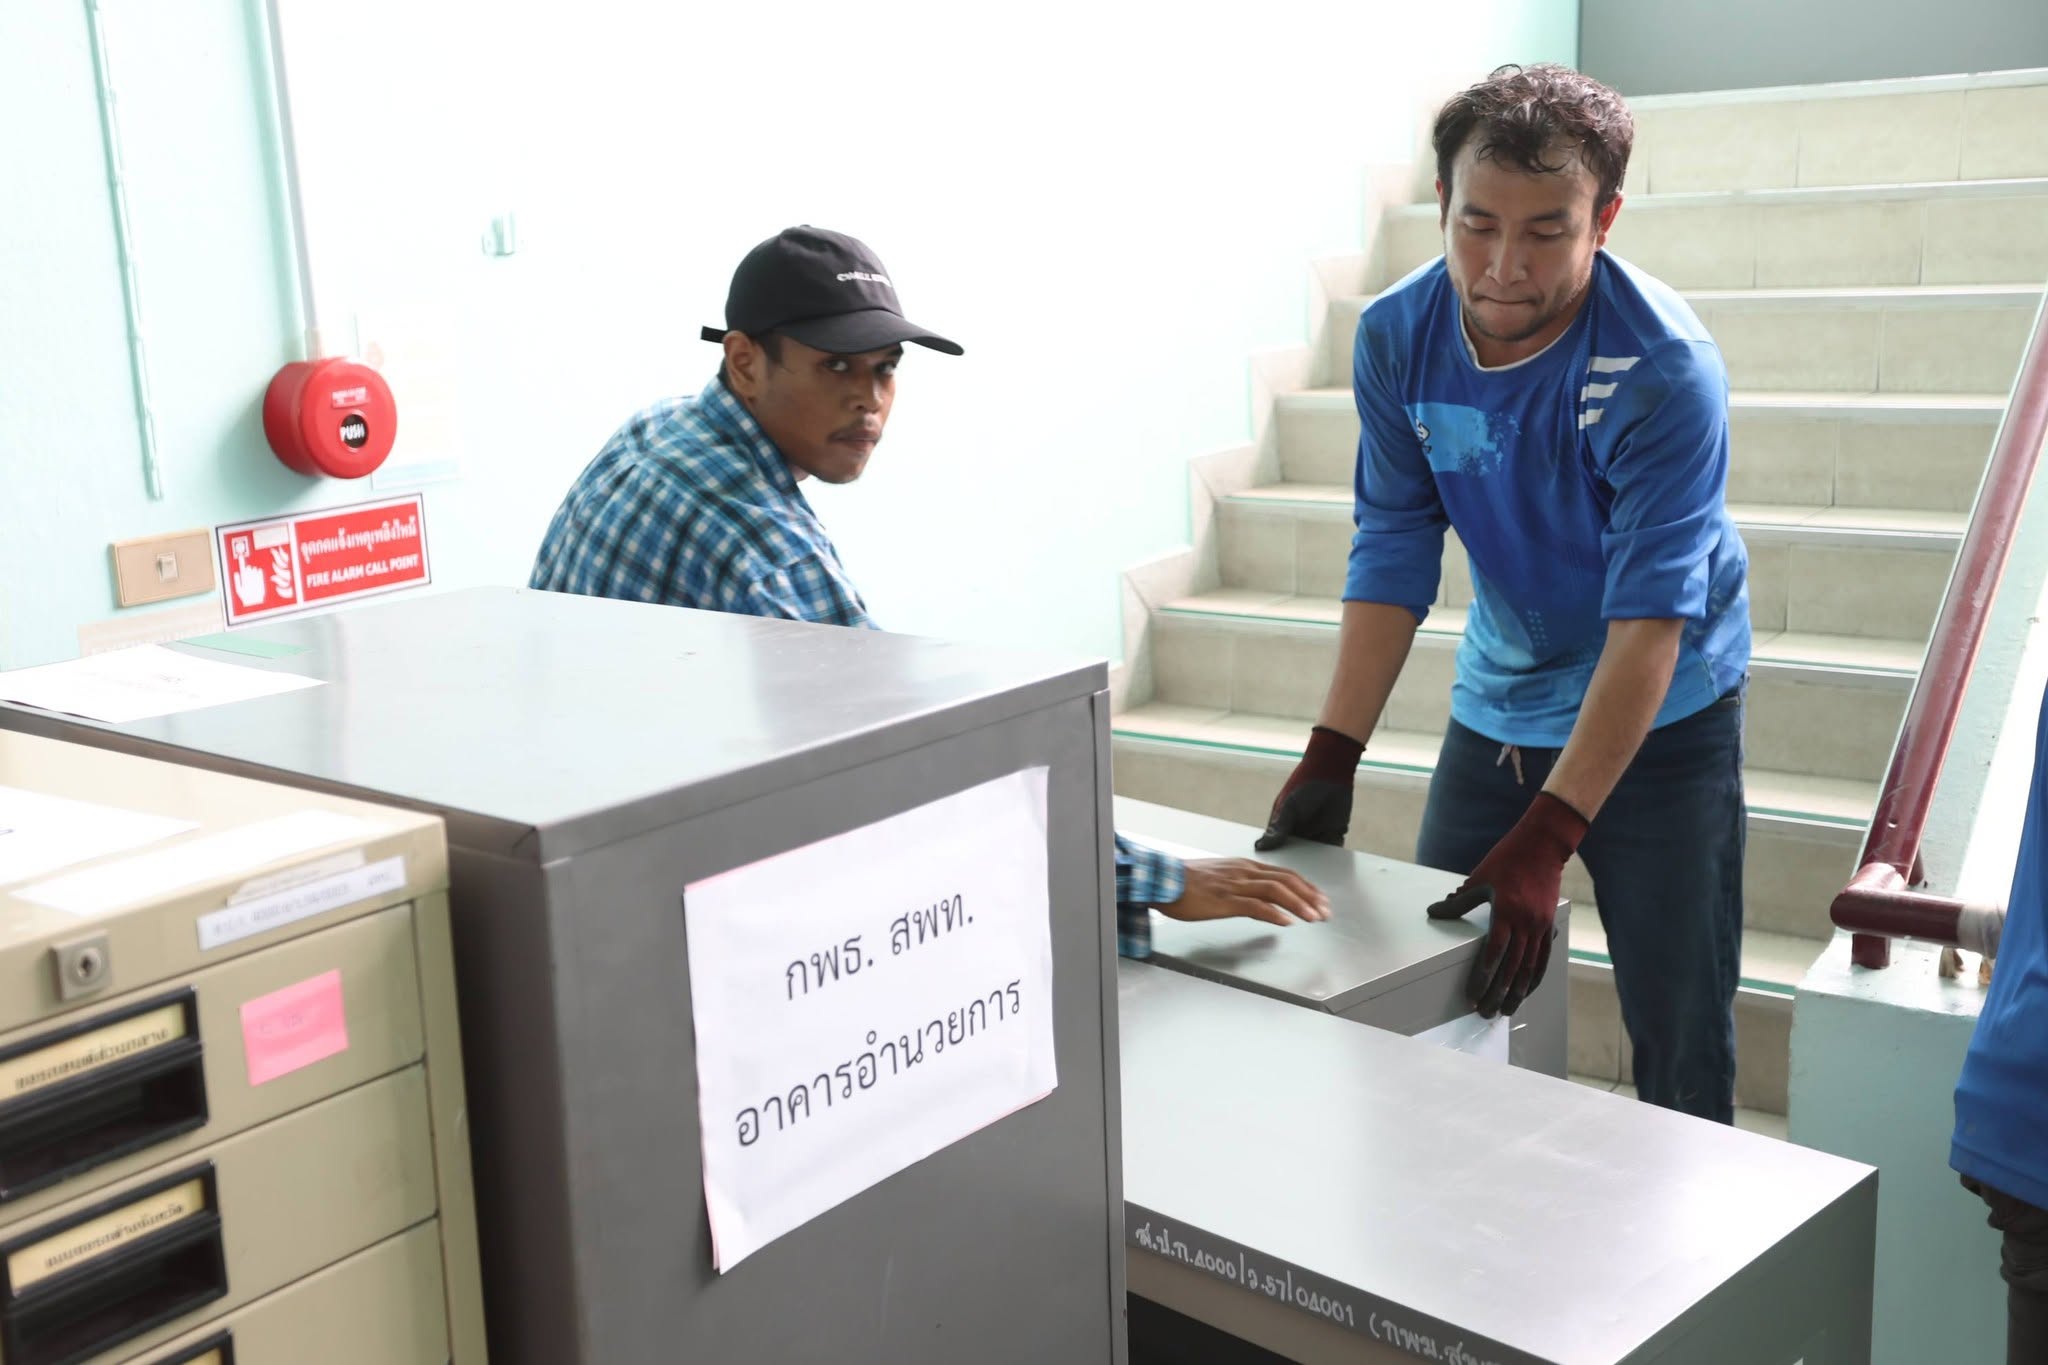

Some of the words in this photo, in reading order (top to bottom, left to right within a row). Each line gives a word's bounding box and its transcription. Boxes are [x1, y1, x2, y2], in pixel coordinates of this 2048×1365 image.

[301, 516, 417, 563] จุดกดแจ้งเหตุเพลิงไหม้
[307, 570, 330, 588] FIRE
[332, 565, 364, 584] ALARM
[366, 559, 389, 577] CALL
[391, 554, 418, 572] POINT
[785, 934, 874, 1000] กพธ.
[889, 893, 973, 955] สพท.
[735, 979, 1021, 1147] อาคารอำนวยการ
